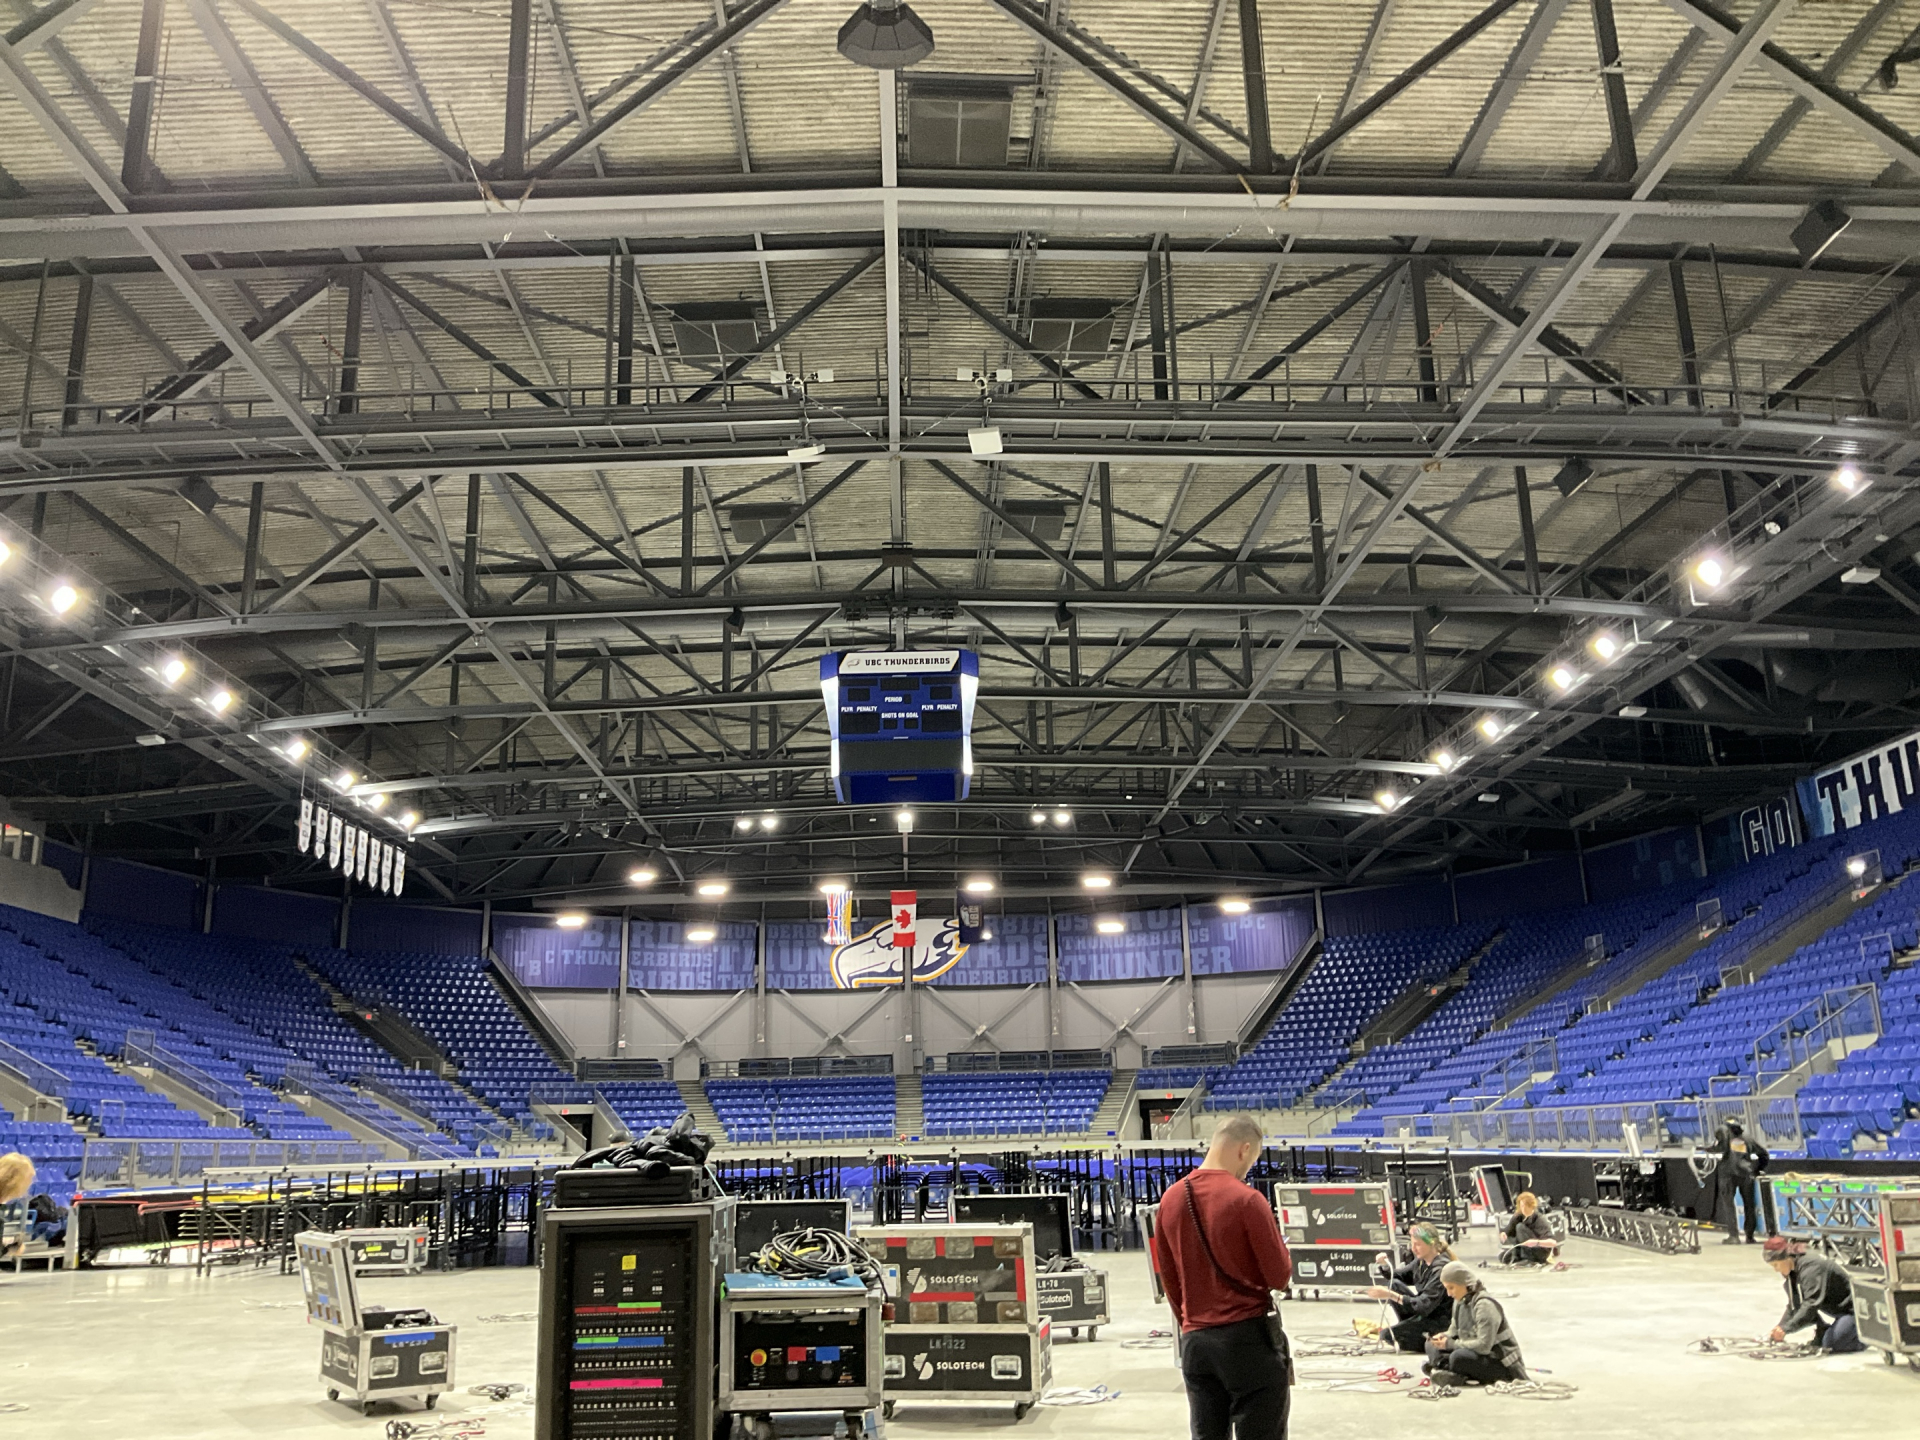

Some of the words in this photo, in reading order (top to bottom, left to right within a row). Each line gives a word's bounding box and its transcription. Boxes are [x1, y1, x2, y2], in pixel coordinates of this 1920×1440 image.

[884, 657, 951, 666] THUNDERBIRDS
[930, 1274, 979, 1284] SOLOTECH
[936, 1361, 985, 1370] SOLOTECH
